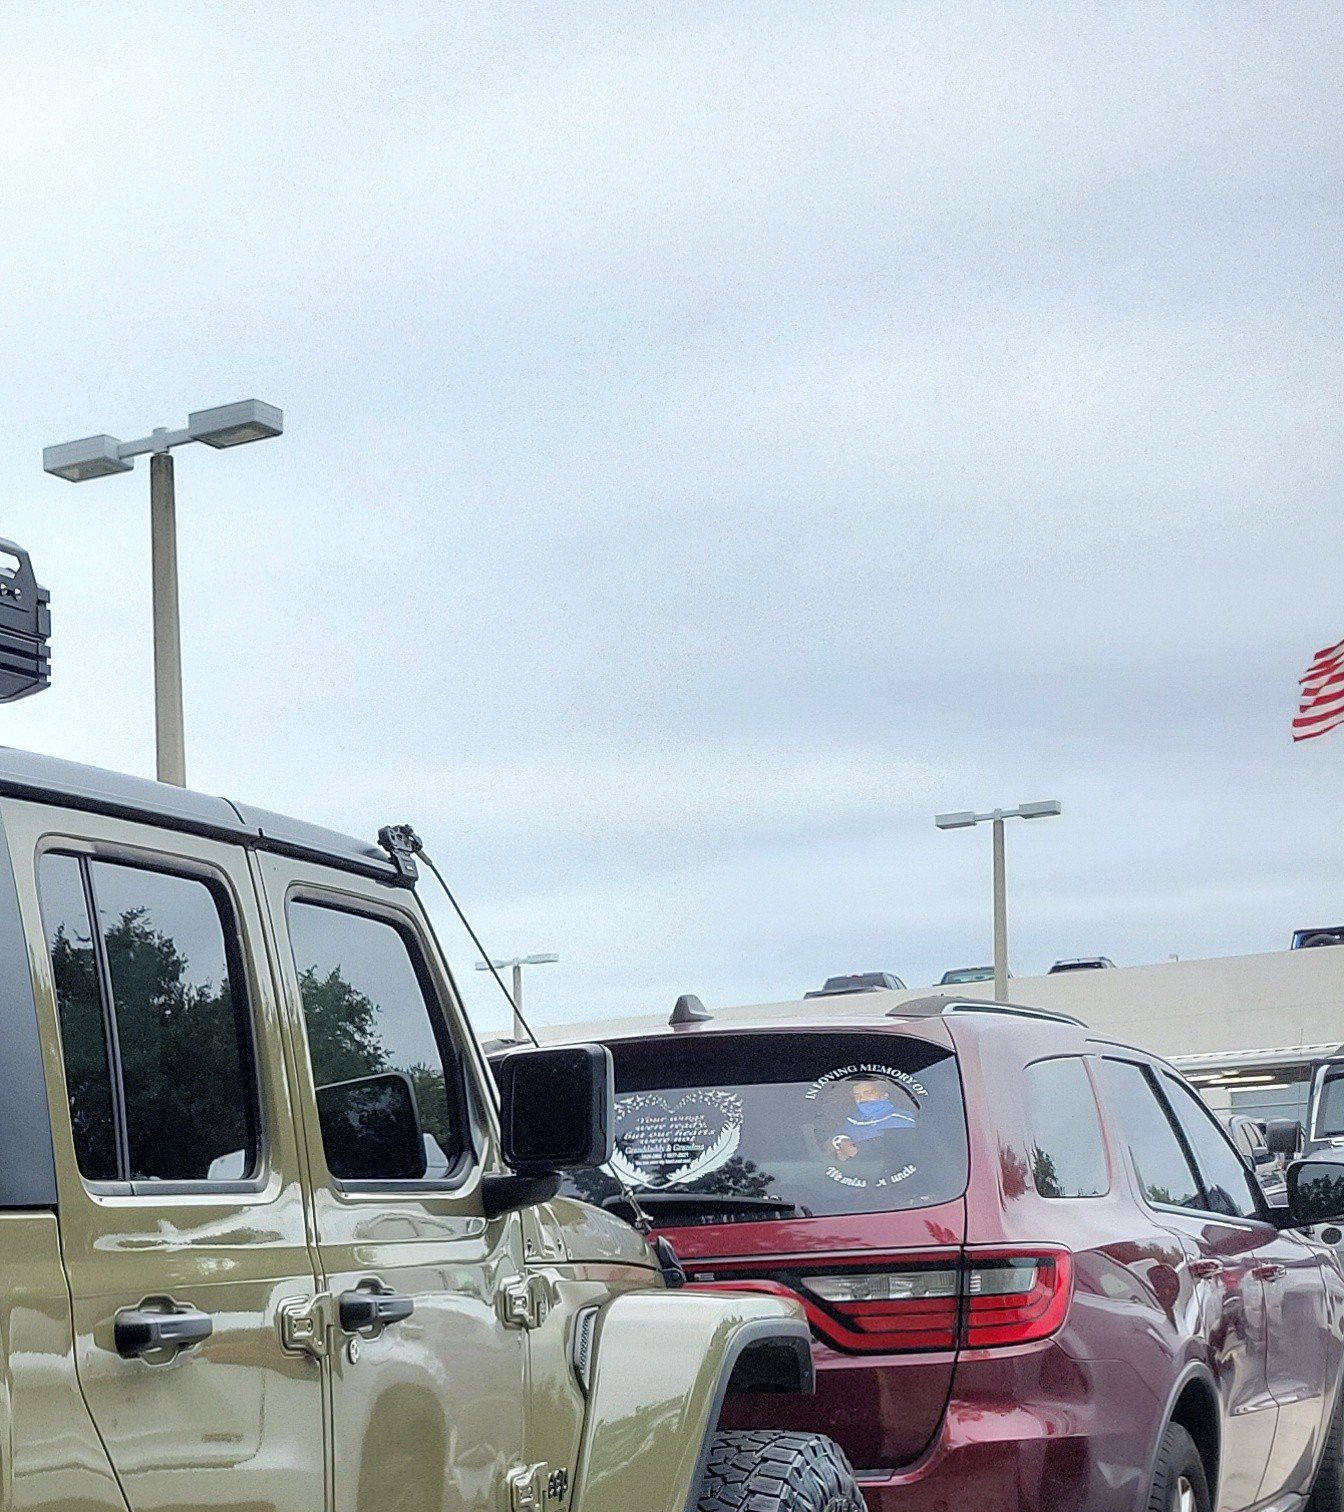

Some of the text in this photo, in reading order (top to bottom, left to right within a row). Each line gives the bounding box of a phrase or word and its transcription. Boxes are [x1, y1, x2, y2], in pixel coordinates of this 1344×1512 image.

[805, 1089, 819, 1100] IN
[815, 1064, 858, 1092] LOVING
[859, 1063, 917, 1086] MEMORY
